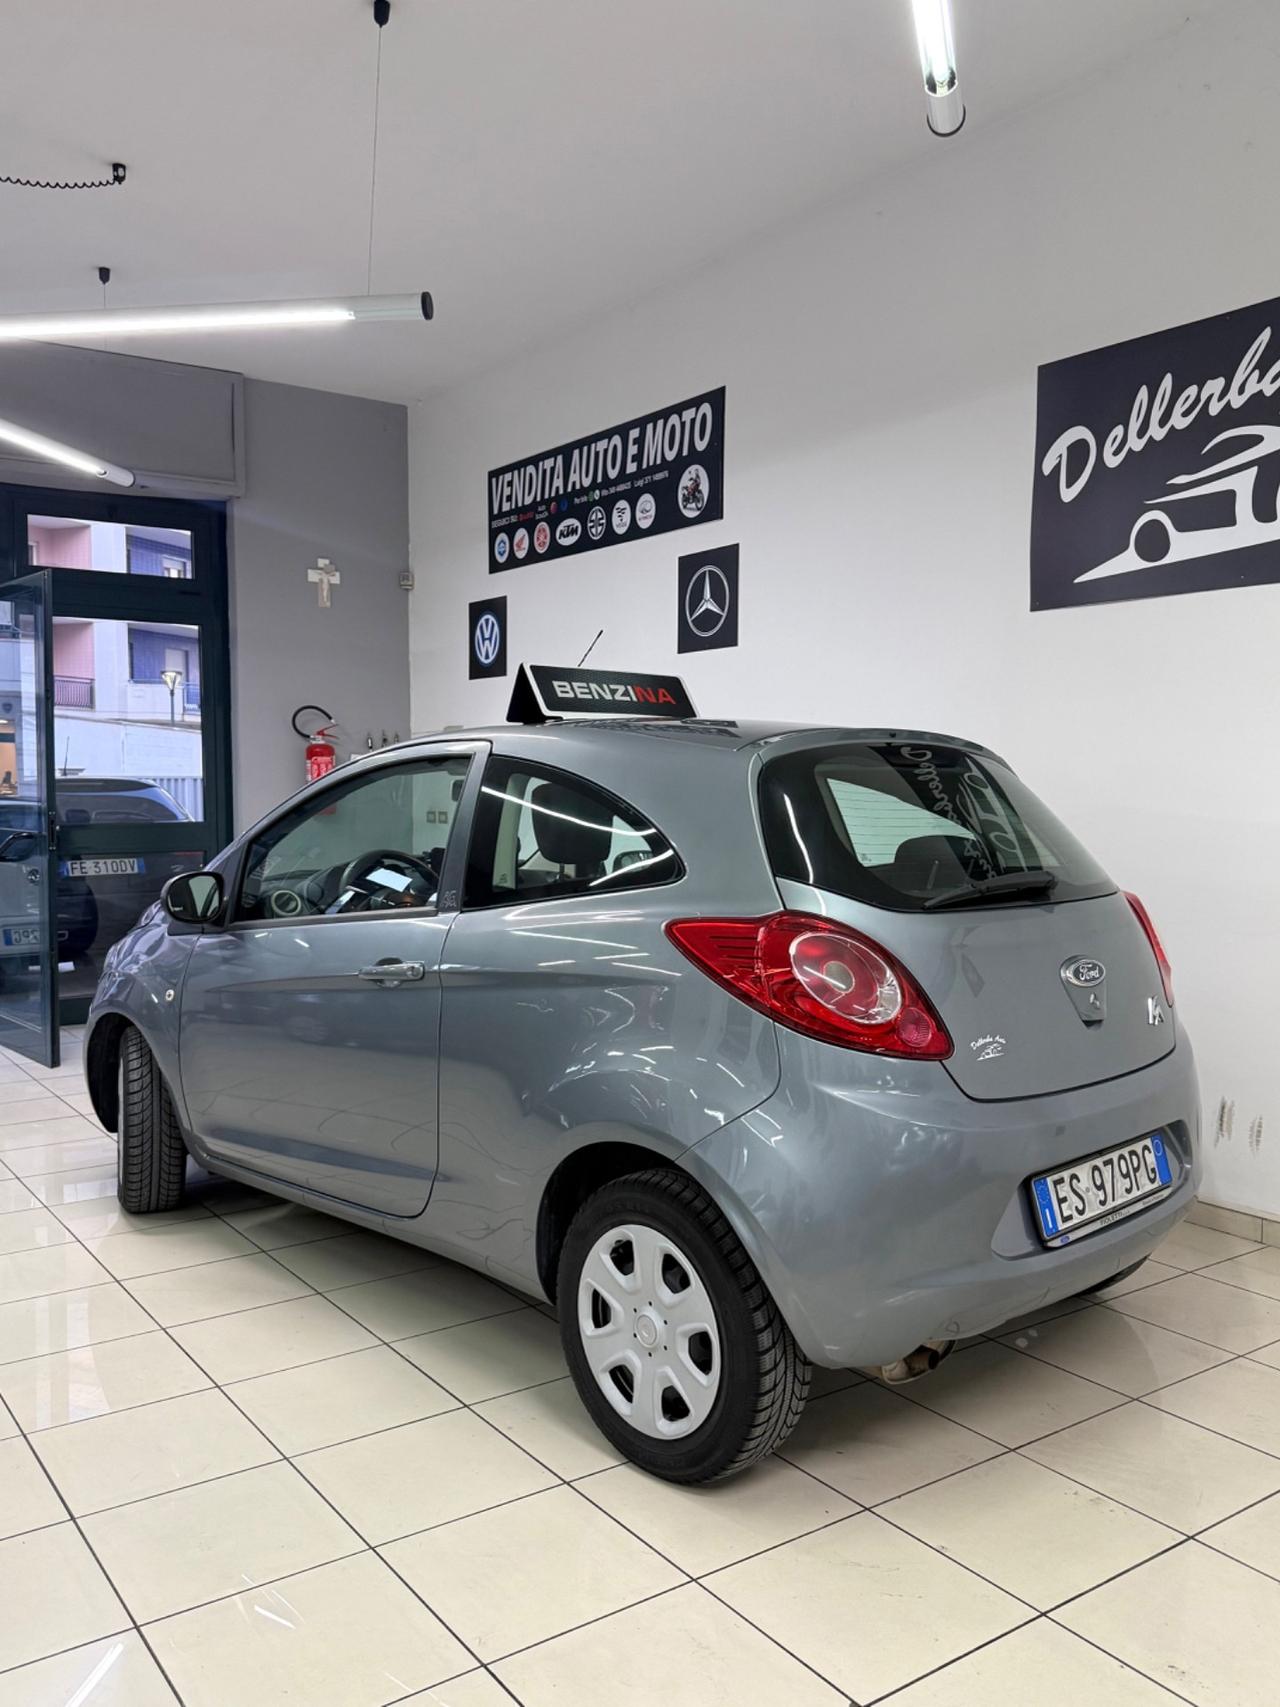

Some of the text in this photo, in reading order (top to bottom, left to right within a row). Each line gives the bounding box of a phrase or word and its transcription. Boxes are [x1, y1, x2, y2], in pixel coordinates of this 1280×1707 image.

[491, 402, 713, 515] VENDITA AUTO E MOTO
[559, 523, 579, 540] KTM
[552, 680, 676, 704] BENZINA
[70, 860, 136, 875] FE 310DV
[1079, 963, 1100, 981] Ford
[1052, 1144, 1157, 1224] ES 979PG
